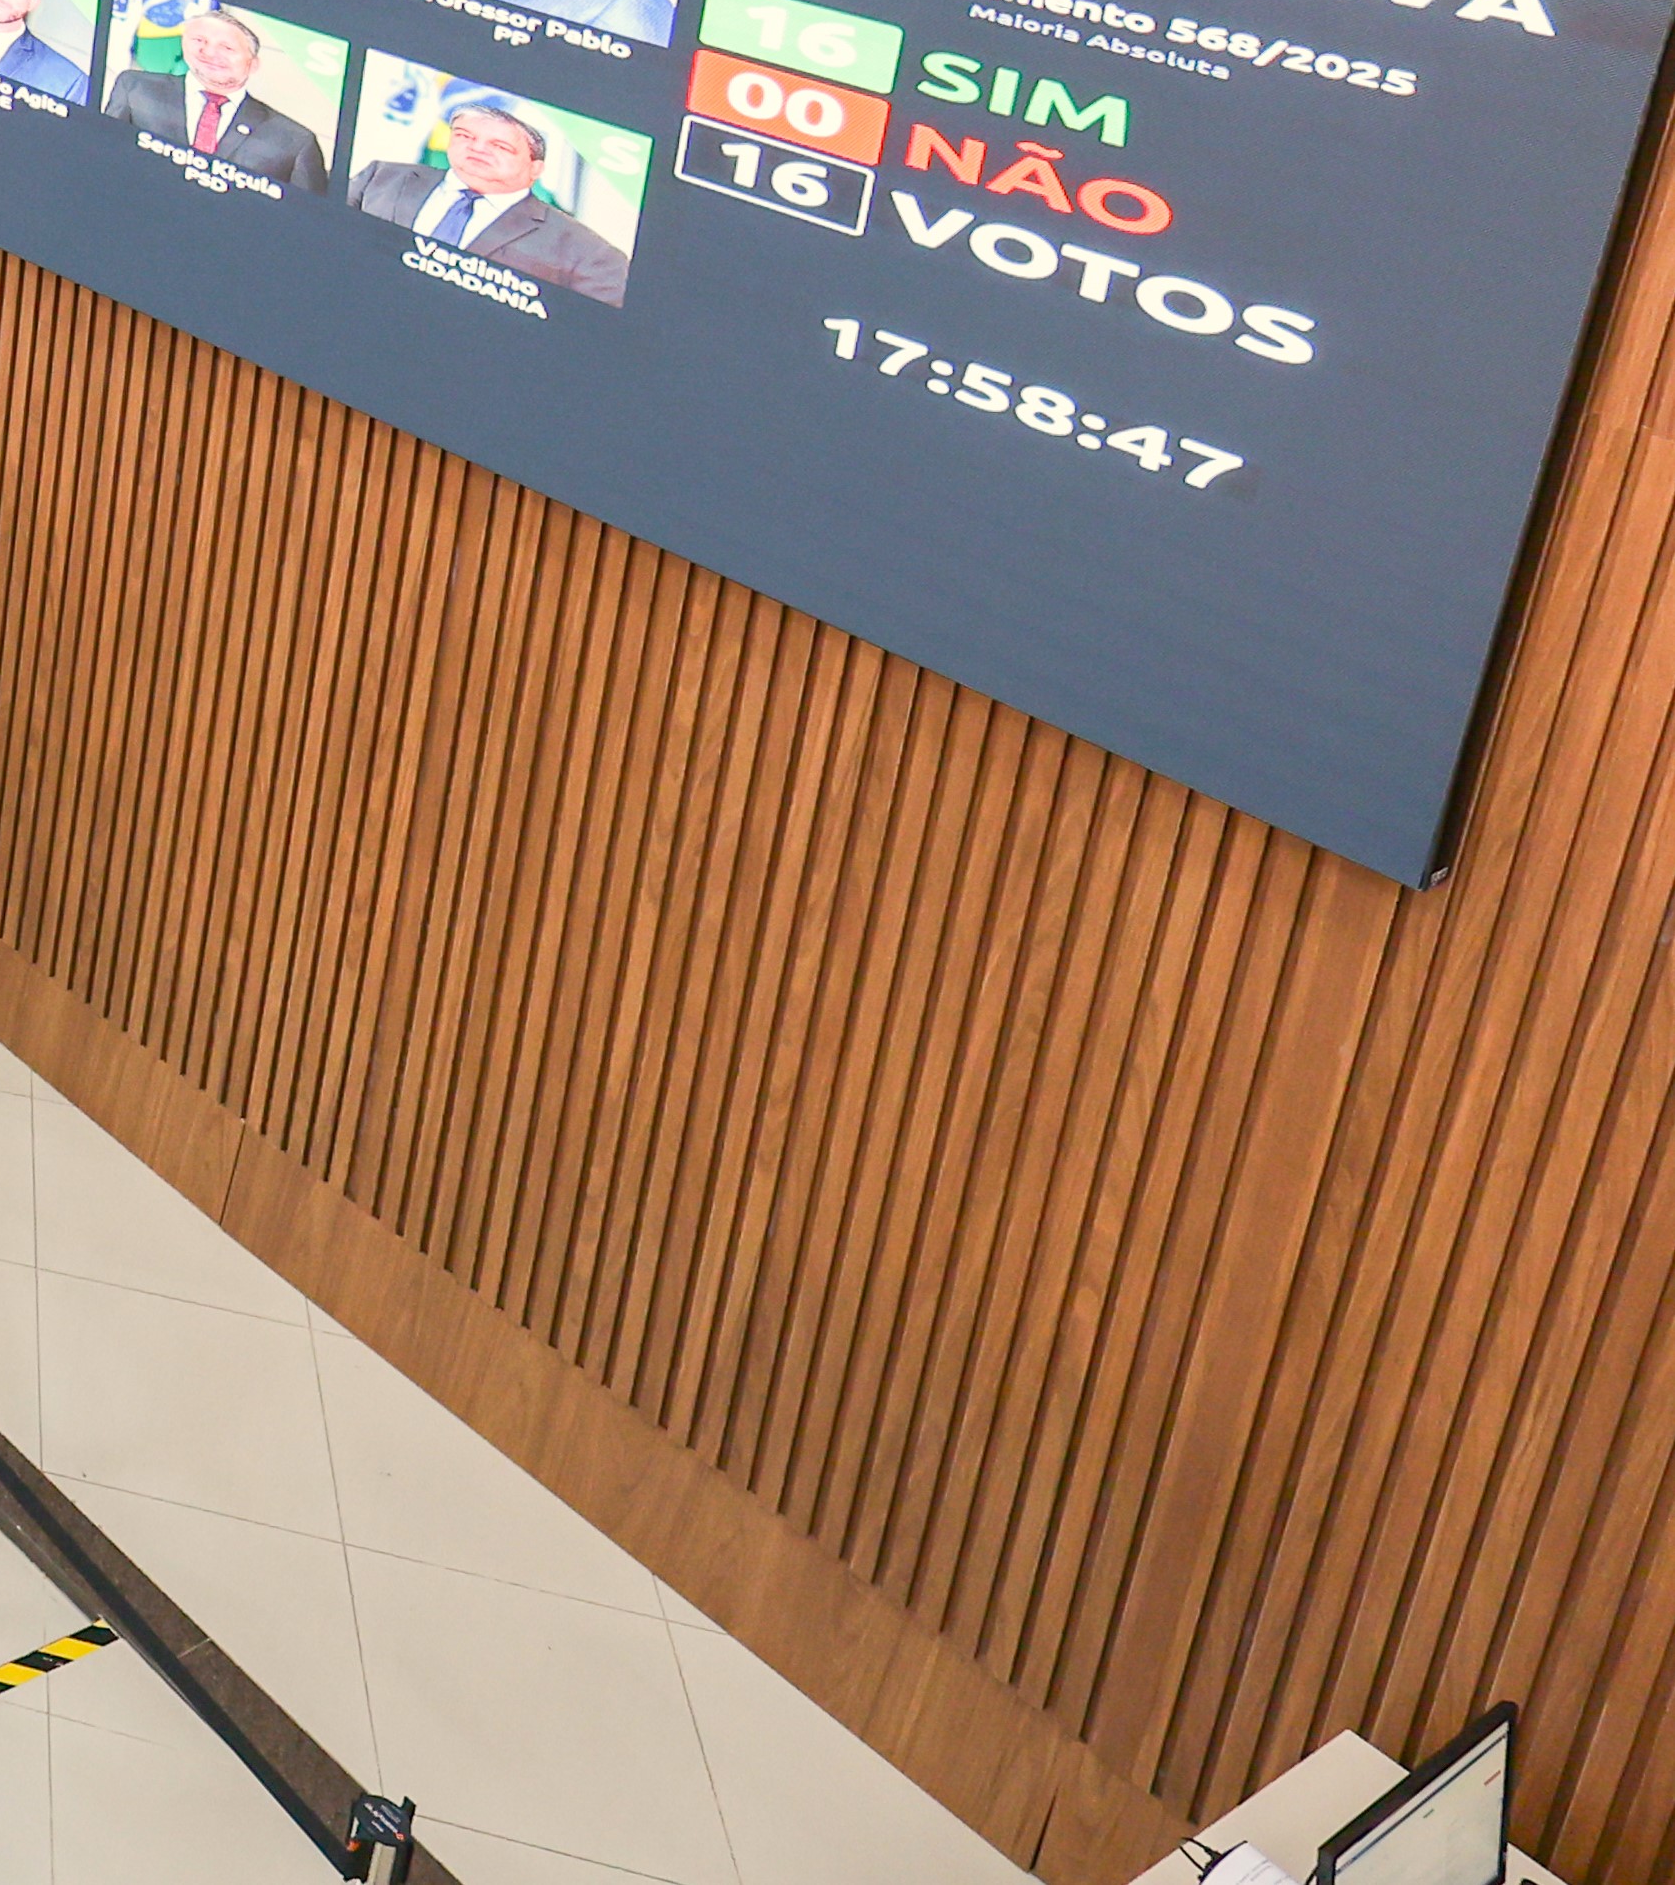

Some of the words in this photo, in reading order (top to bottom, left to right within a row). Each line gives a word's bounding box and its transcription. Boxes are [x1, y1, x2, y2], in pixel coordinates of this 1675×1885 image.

[492, 22, 533, 47] PP
[545, 21, 633, 60] Pablo
[968, 3, 1081, 45] Maioria
[1085, 31, 1231, 82] Absoluta
[1164, 16, 1421, 98] 568/2025
[14, 85, 69, 118] Agita
[745, 2, 861, 72] 16
[915, 50, 1132, 150] SIM
[136, 130, 210, 173] Sergio
[210, 160, 285, 201] Kiçula
[183, 165, 230, 195] PSD
[724, 70, 846, 140] 00
[902, 123, 1175, 237] NÃO
[400, 250, 549, 320] CIDADANIA
[412, 235, 542, 298] Vardinho
[718, 141, 832, 210] 16
[888, 188, 1320, 367] VOTOS
[821, 314, 1247, 494] 17:58:47
